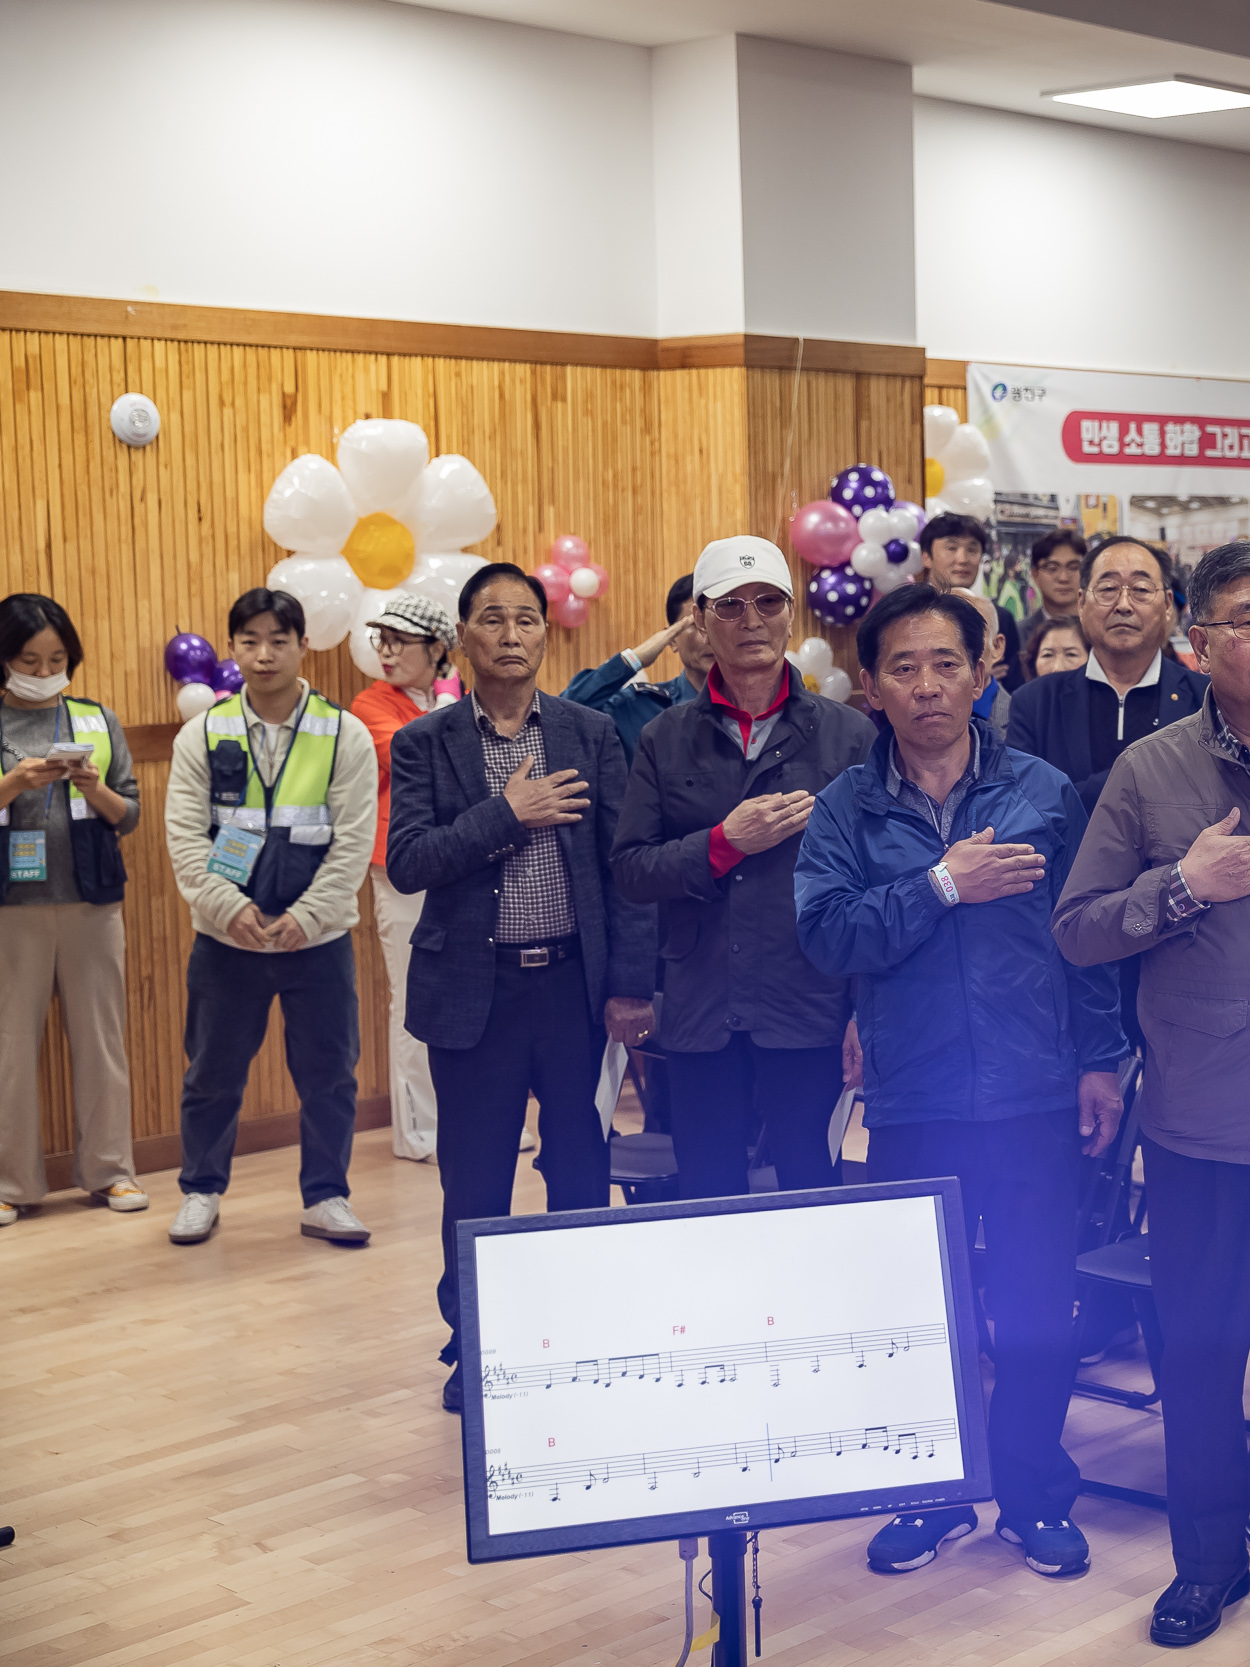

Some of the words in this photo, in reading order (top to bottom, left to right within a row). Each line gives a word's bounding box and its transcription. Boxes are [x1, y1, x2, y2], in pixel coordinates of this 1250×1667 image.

[1080, 419, 1120, 455] 민생
[1123, 421, 1161, 457] 소통
[1164, 421, 1201, 457] 화합
[11, 869, 40, 879] STAFF
[212, 862, 243, 878] STAFF
[542, 1339, 550, 1349] B
[672, 1325, 686, 1335] F#
[767, 1316, 775, 1326] B
[491, 1392, 513, 1400] Melody
[547, 1437, 556, 1447] B
[496, 1493, 518, 1501] Melody
